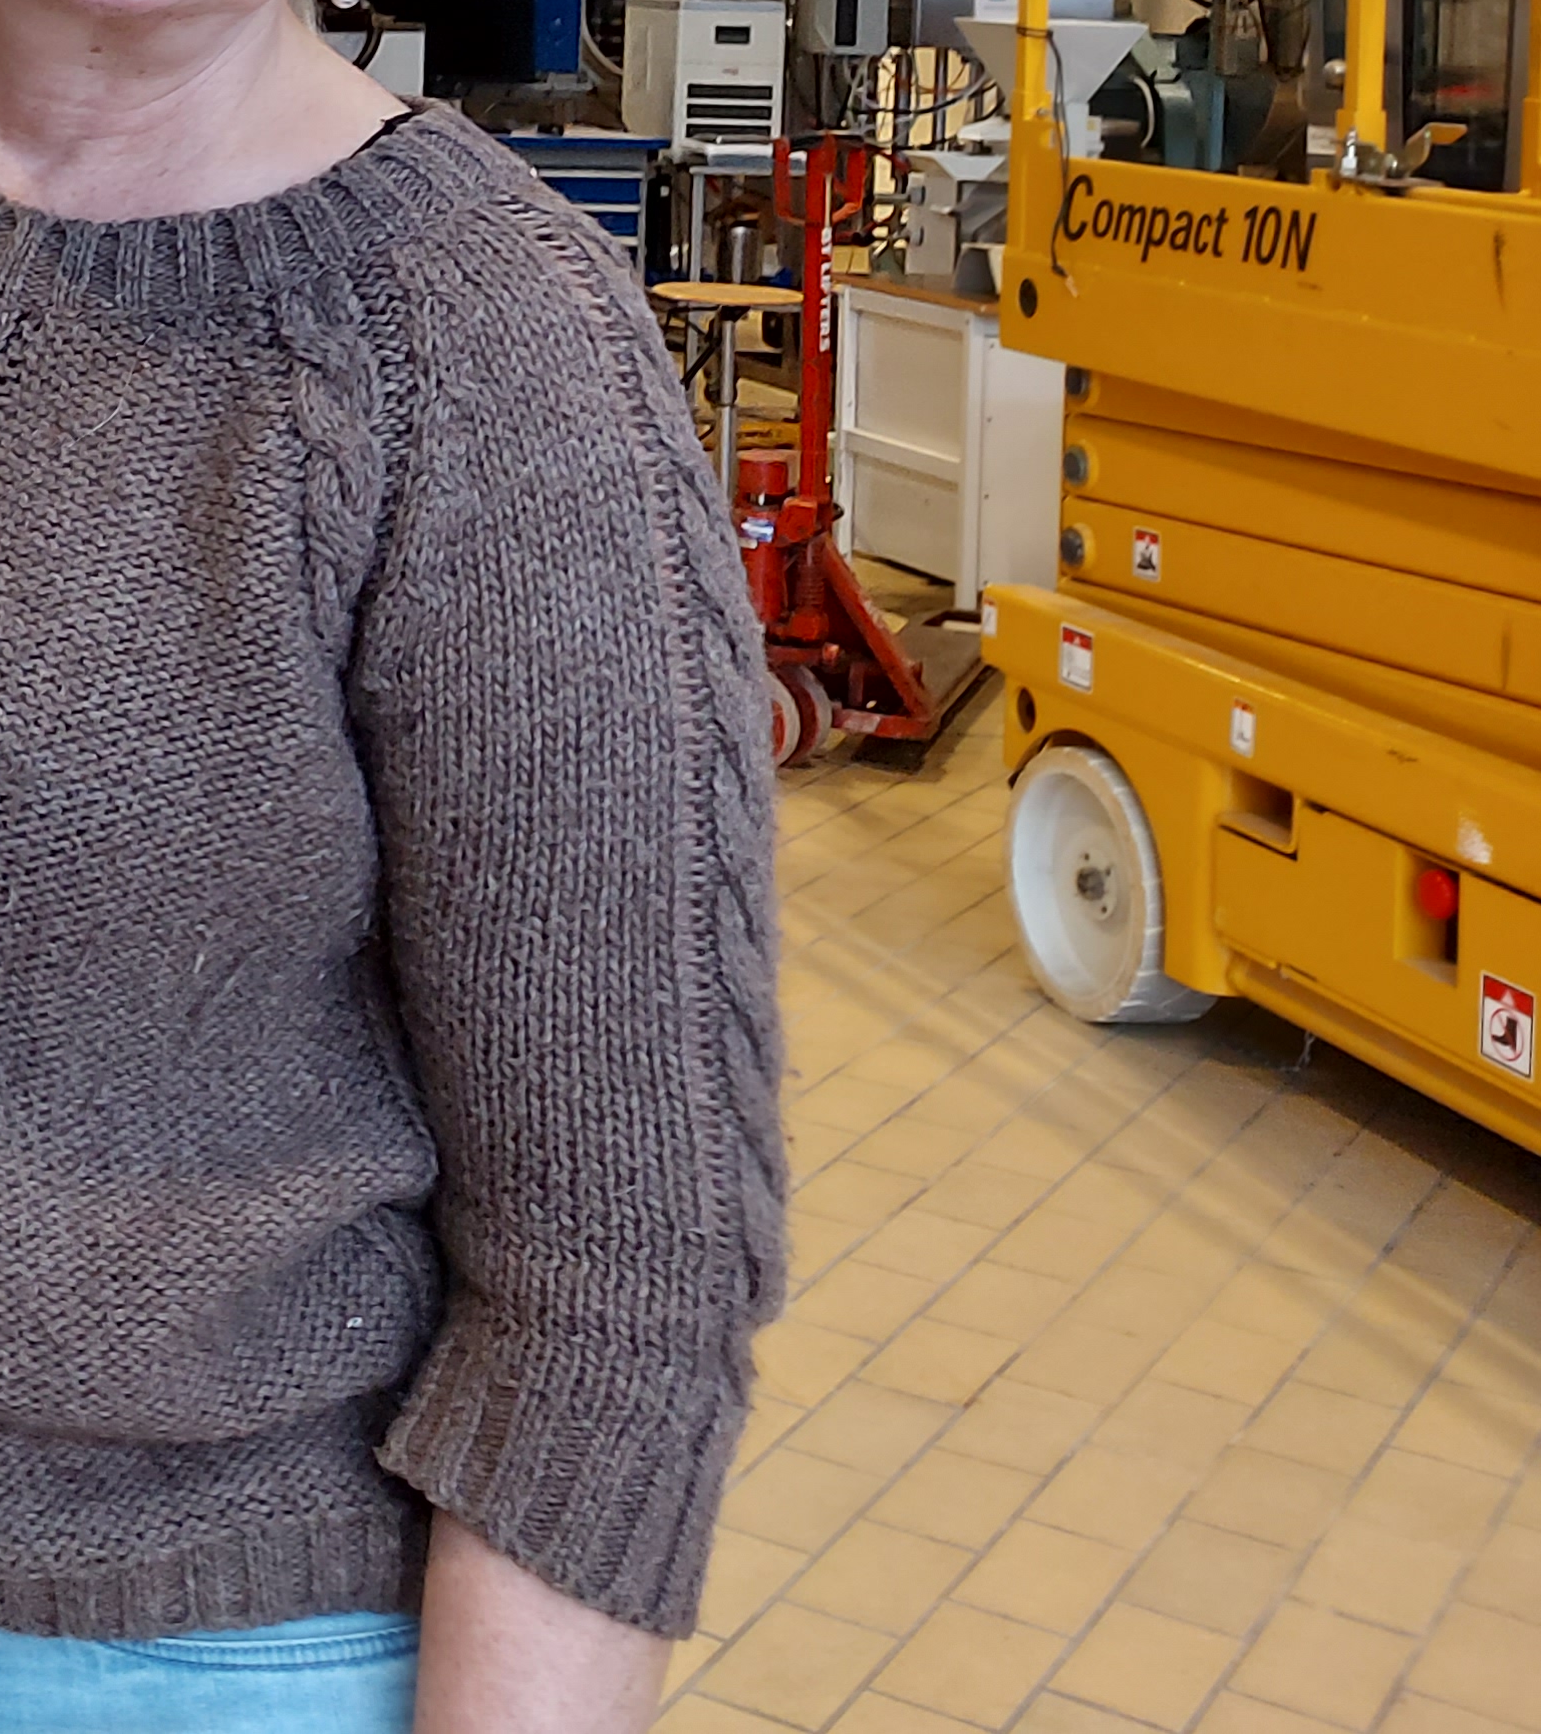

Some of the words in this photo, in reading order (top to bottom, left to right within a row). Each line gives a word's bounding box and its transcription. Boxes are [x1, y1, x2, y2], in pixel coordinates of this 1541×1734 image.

[1063, 174, 1229, 263] Compact
[1241, 205, 1317, 272] 10N
[819, 261, 832, 353] LIFTERS
